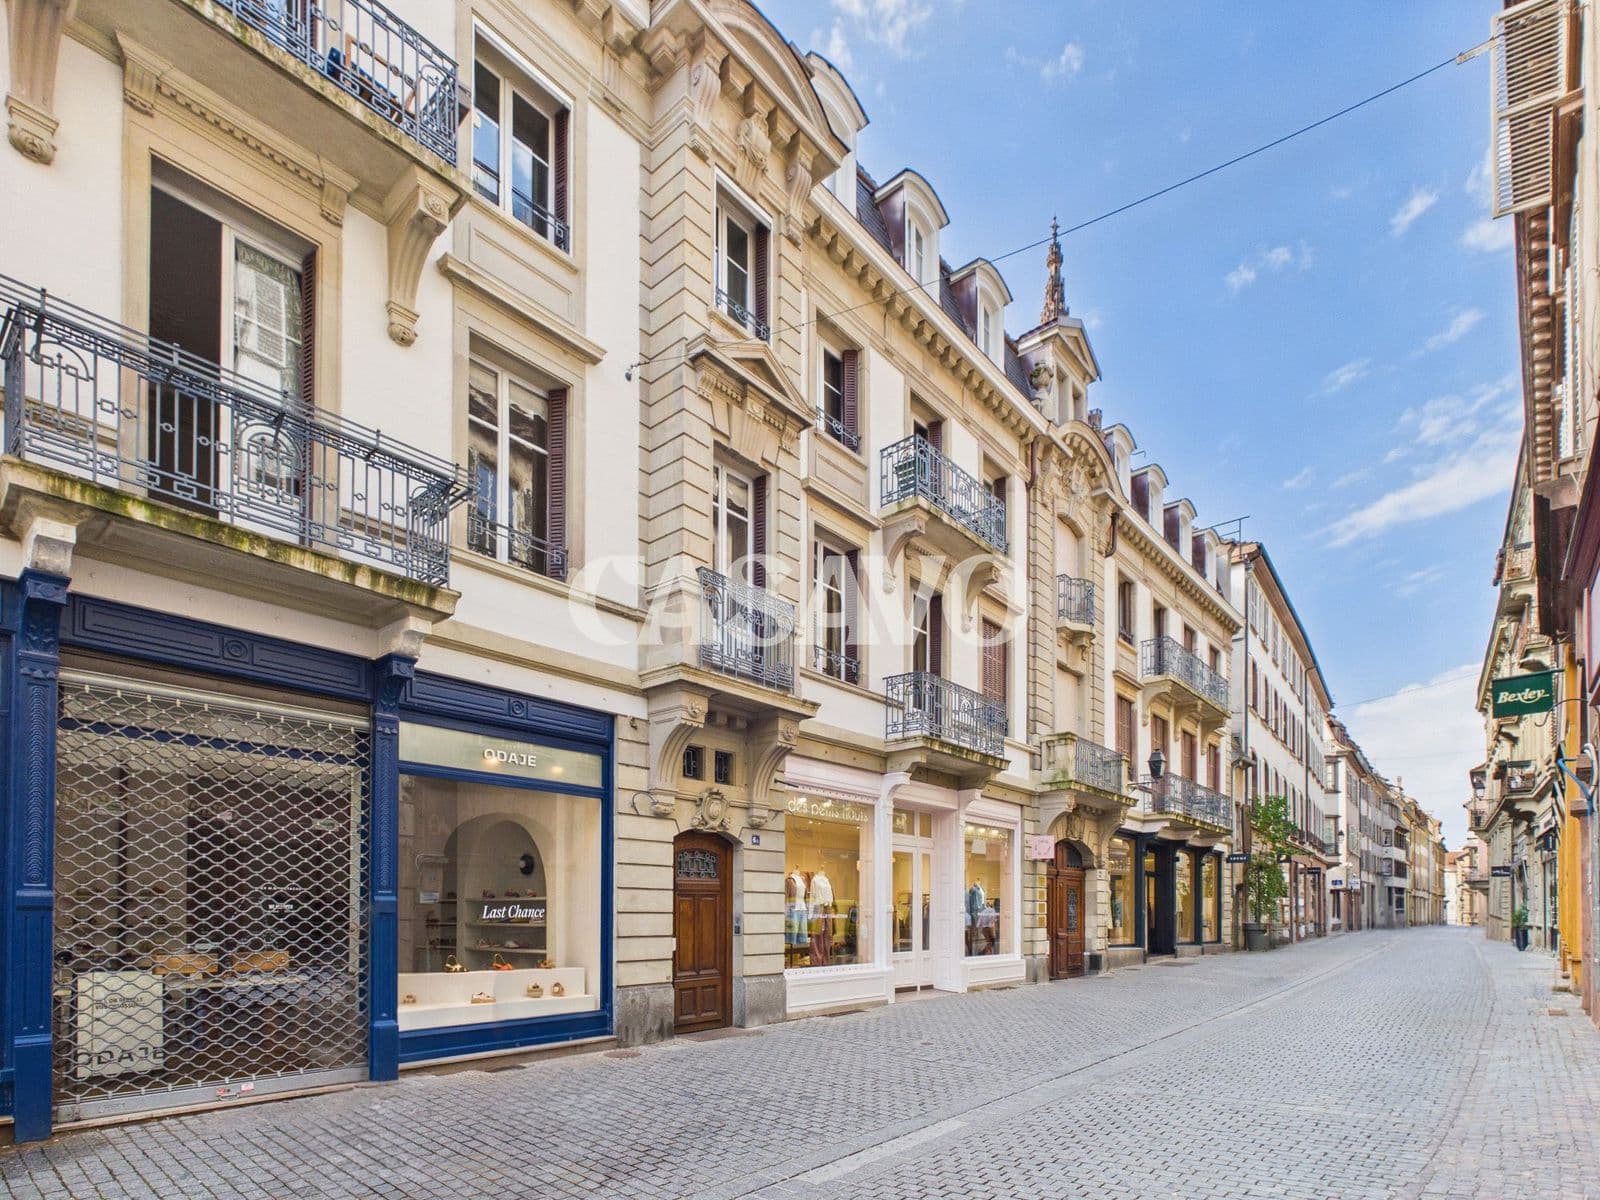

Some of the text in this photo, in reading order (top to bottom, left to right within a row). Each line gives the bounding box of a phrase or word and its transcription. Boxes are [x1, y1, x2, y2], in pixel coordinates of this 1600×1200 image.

[1496, 688, 1550, 704] Bexley
[483, 748, 537, 767] ODAJE
[482, 904, 545, 919] Last Chance
